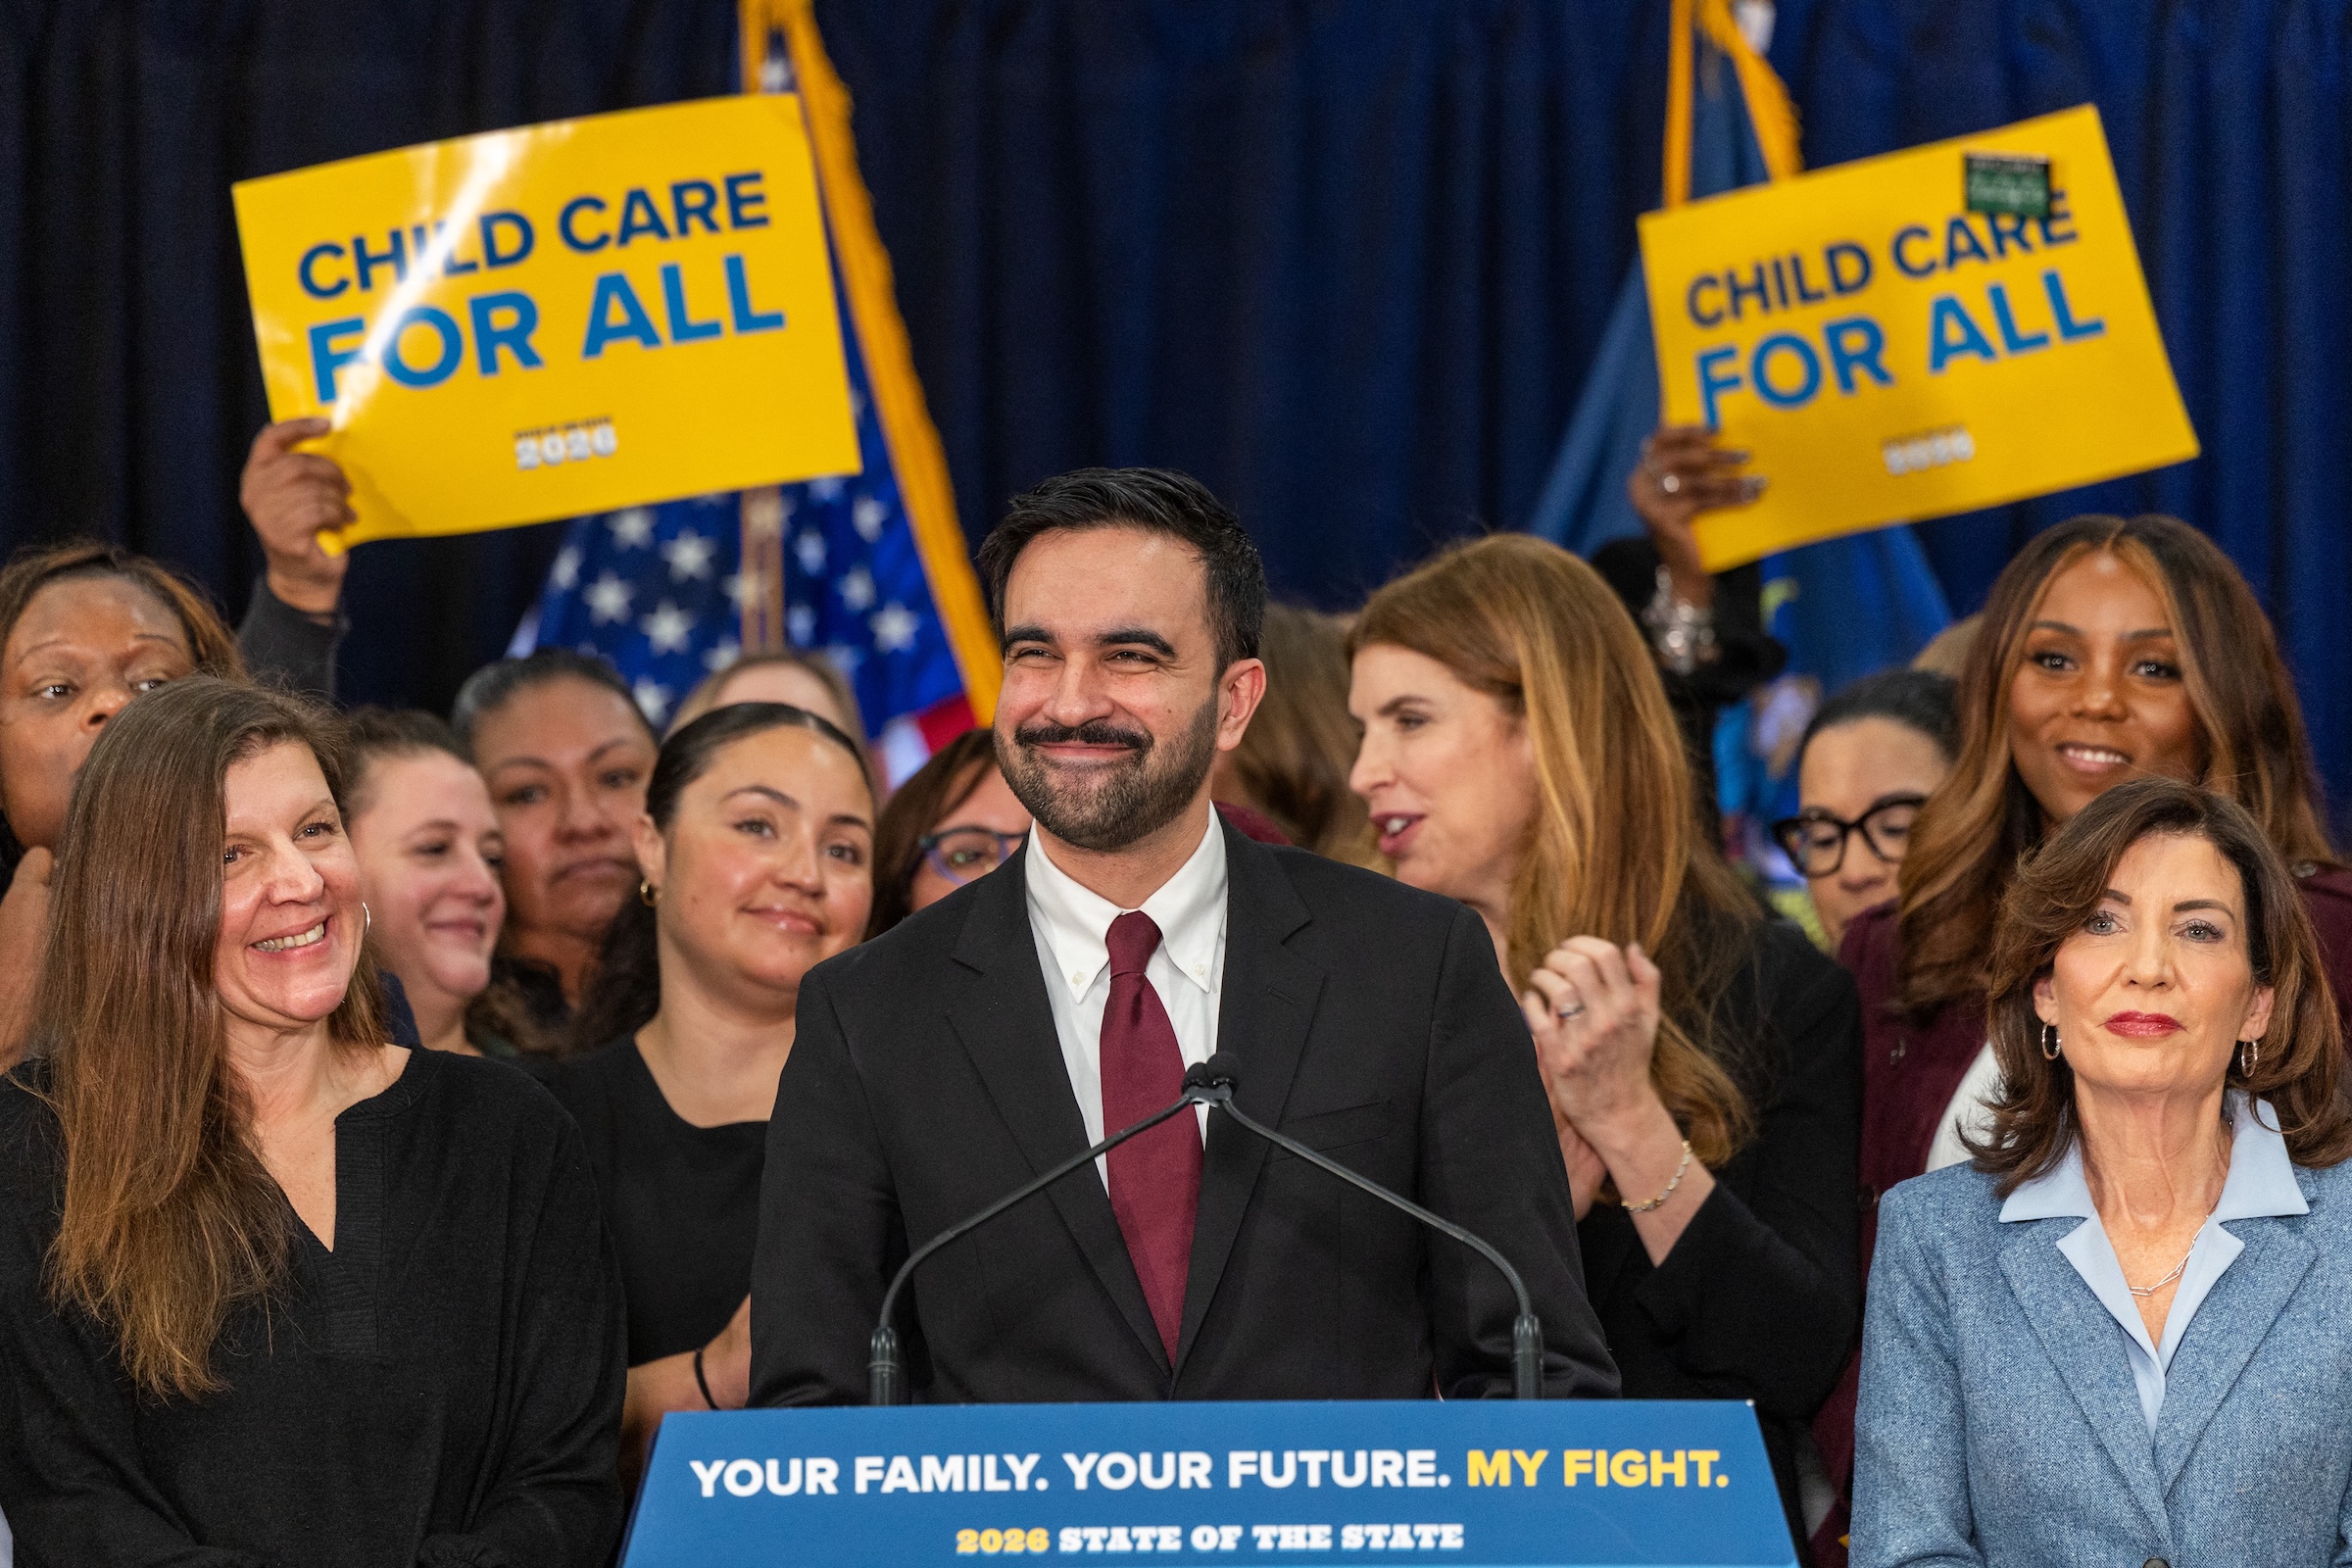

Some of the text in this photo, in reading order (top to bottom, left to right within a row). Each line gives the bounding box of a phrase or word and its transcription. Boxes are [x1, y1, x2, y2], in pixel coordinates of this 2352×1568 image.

[297, 171, 770, 300] CHILD CARE
[1688, 190, 2078, 326] CHILD CARE
[307, 254, 787, 406] FOR ALL
[1695, 270, 2105, 432] FOR ALL
[689, 1448, 1731, 1497] YOUR FAMILY. YOUR FUTURE. MY FIGHT.
[956, 1523, 1464, 1555] 2026 STATE OF THE STATE
